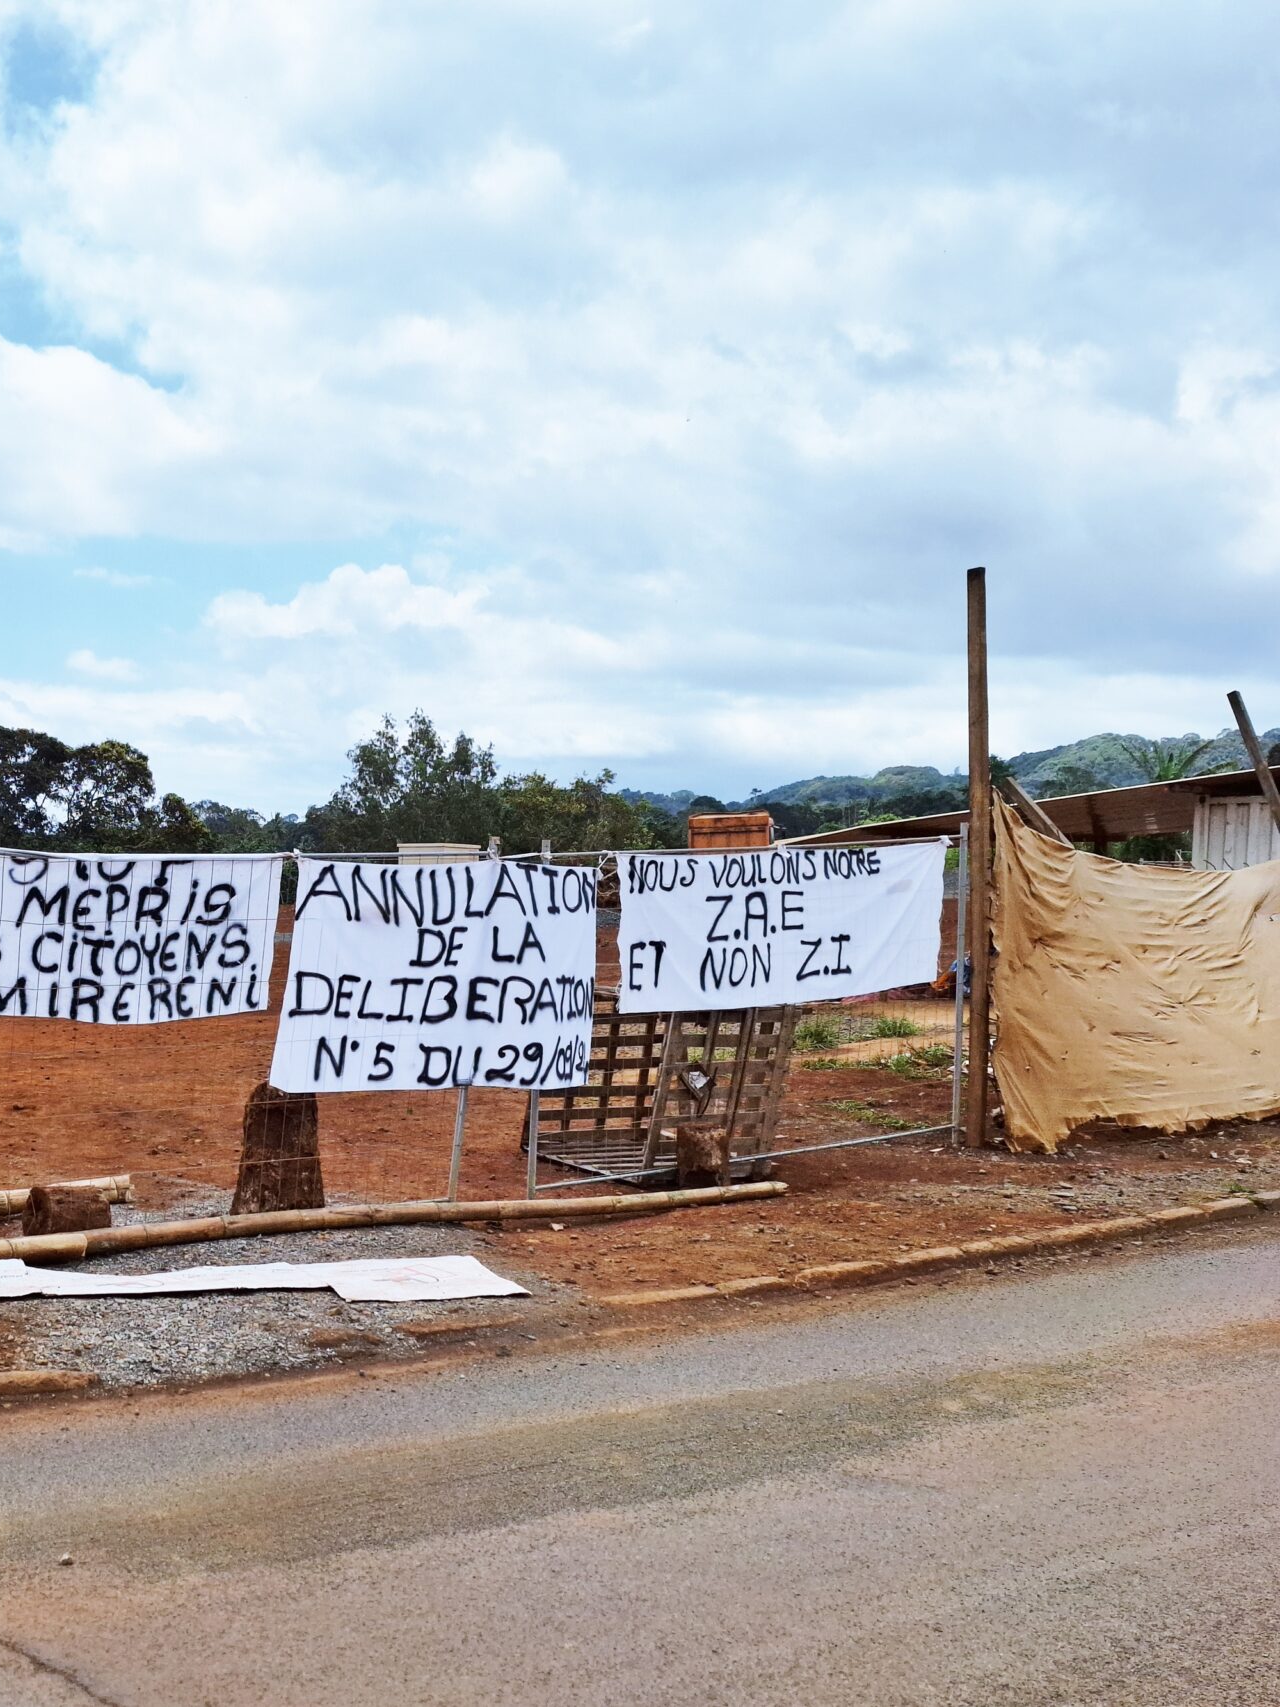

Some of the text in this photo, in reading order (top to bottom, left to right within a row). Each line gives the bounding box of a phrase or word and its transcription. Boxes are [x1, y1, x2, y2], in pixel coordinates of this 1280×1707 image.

[295, 863, 596, 926] ANNULATION
[629, 848, 882, 894] NOUS VOULONS NOTRE
[705, 890, 805, 943] Z.A.E
[409, 921, 546, 966] DE LA
[629, 940, 667, 991] ET
[699, 942, 771, 992] NON
[289, 970, 594, 1025] DELIBERATION
[417, 1042, 483, 1087] DU
